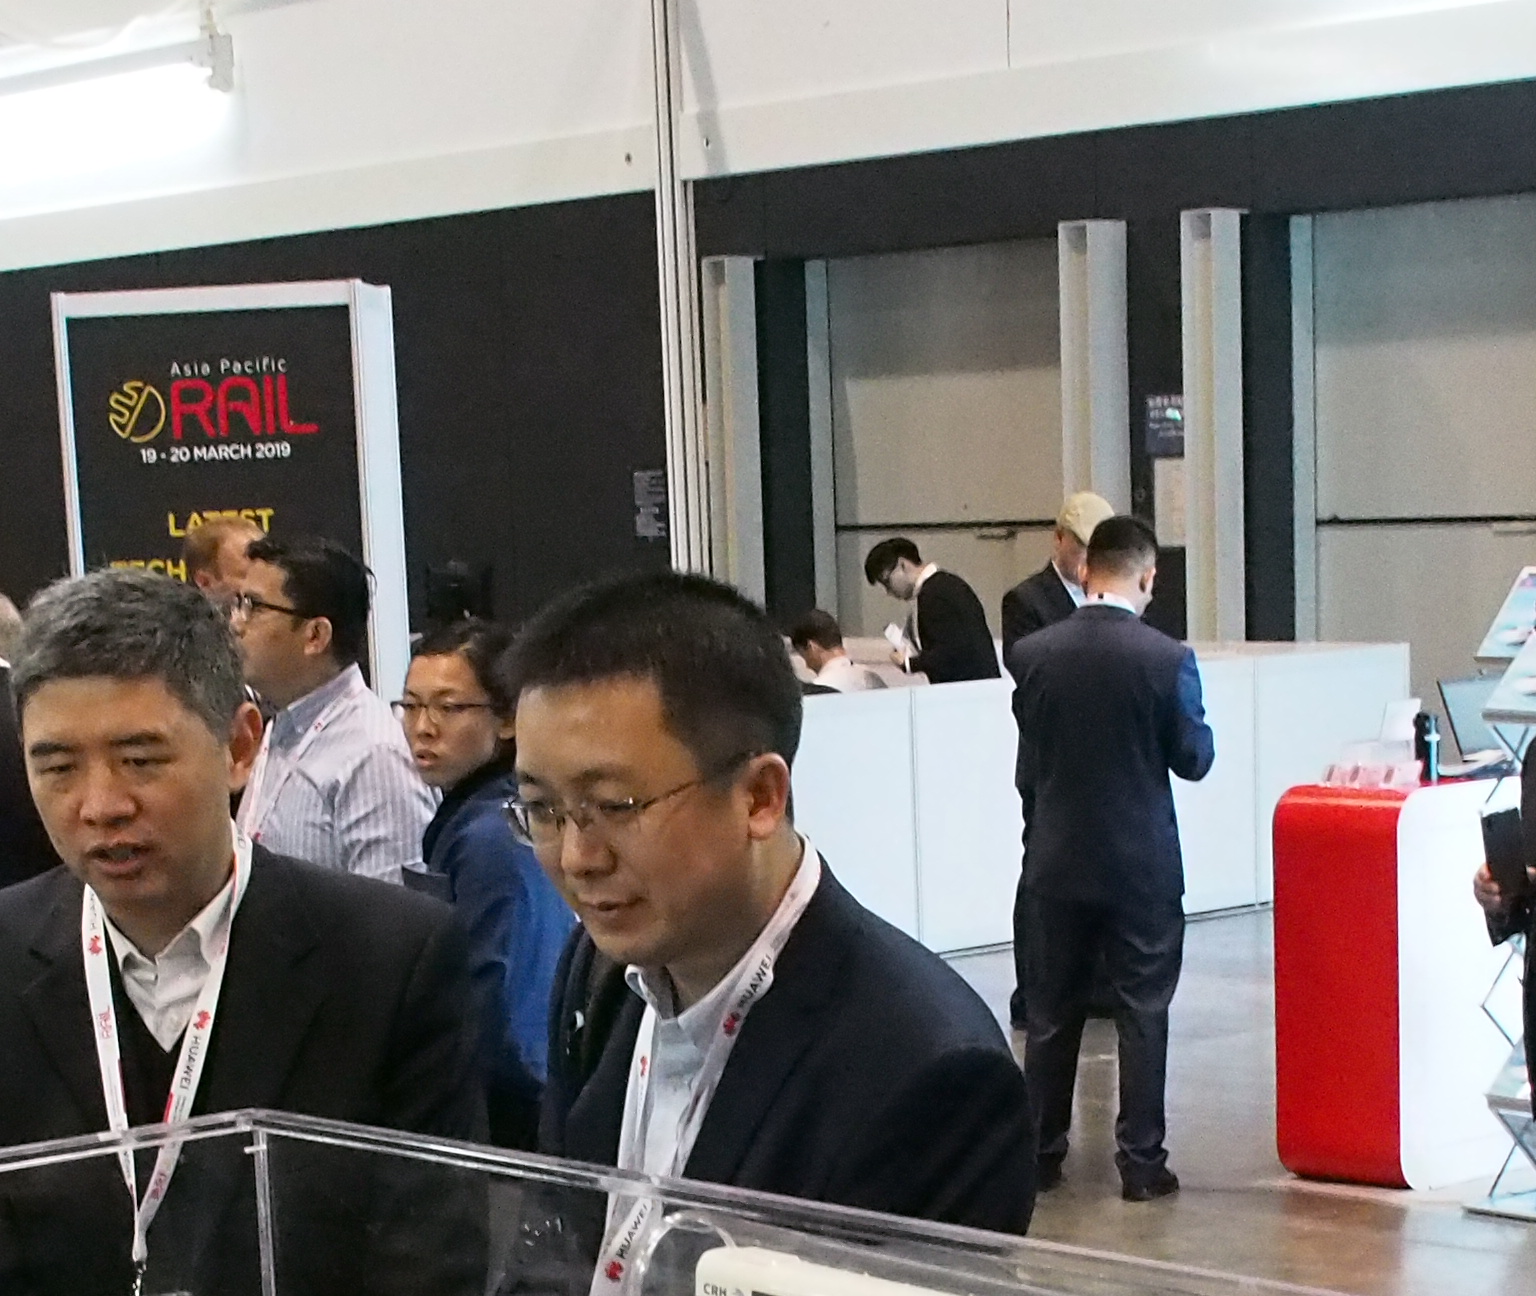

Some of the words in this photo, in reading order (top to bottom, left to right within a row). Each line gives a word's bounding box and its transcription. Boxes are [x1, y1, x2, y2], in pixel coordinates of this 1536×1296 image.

[170, 361, 211, 377] Asia
[220, 356, 288, 375] Pacific
[170, 374, 320, 440] RAIL
[140, 448, 158, 464] 19
[170, 446, 190, 463] 20
[193, 444, 252, 462] MARCH
[255, 440, 291, 459] 2019
[736, 952, 774, 1009] HUAWEI
[179, 1035, 202, 1091] HUAWEI
[615, 1203, 649, 1260] HUAWEI
